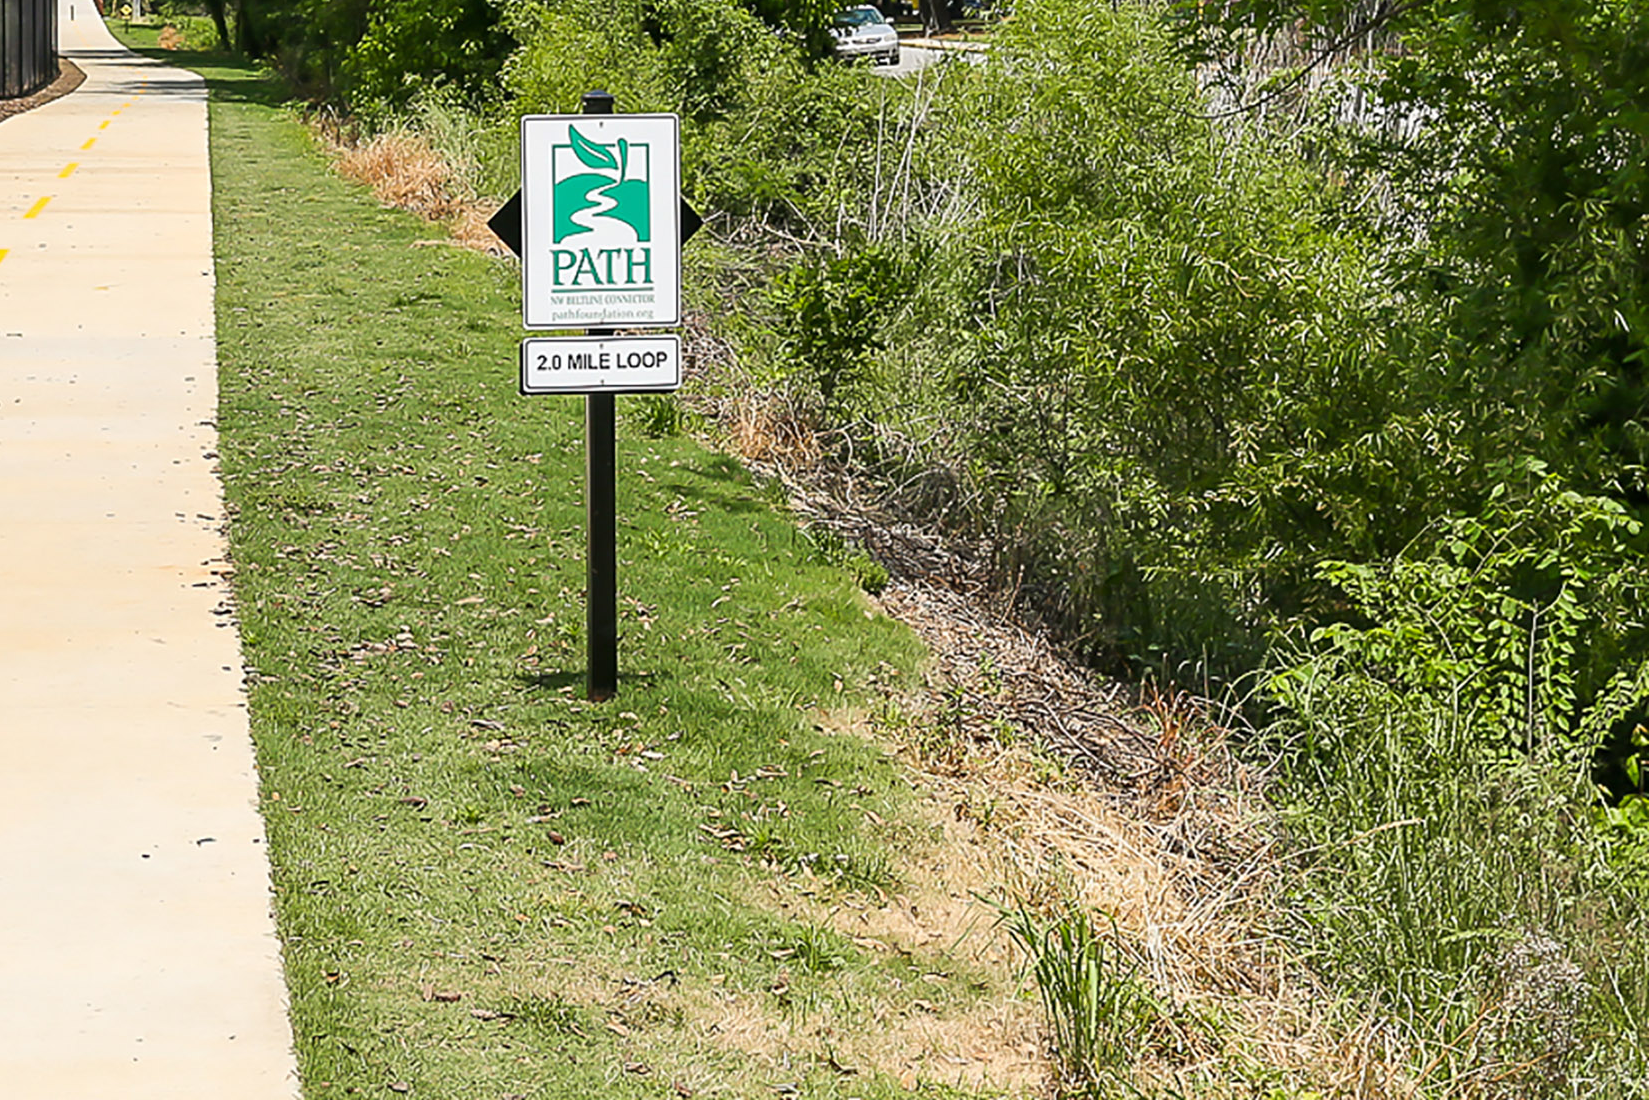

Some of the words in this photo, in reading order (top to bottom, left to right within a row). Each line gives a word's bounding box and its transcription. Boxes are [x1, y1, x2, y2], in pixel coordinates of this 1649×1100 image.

[550, 247, 654, 286] PATH
[551, 295, 564, 305] NW
[566, 294, 603, 305] BELTLINE
[604, 293, 655, 304] CONNECTOR
[552, 307, 654, 321] pathfoundation.org
[537, 354, 561, 371] 2.0
[567, 352, 610, 370] MILE
[616, 351, 668, 368] LOOP
